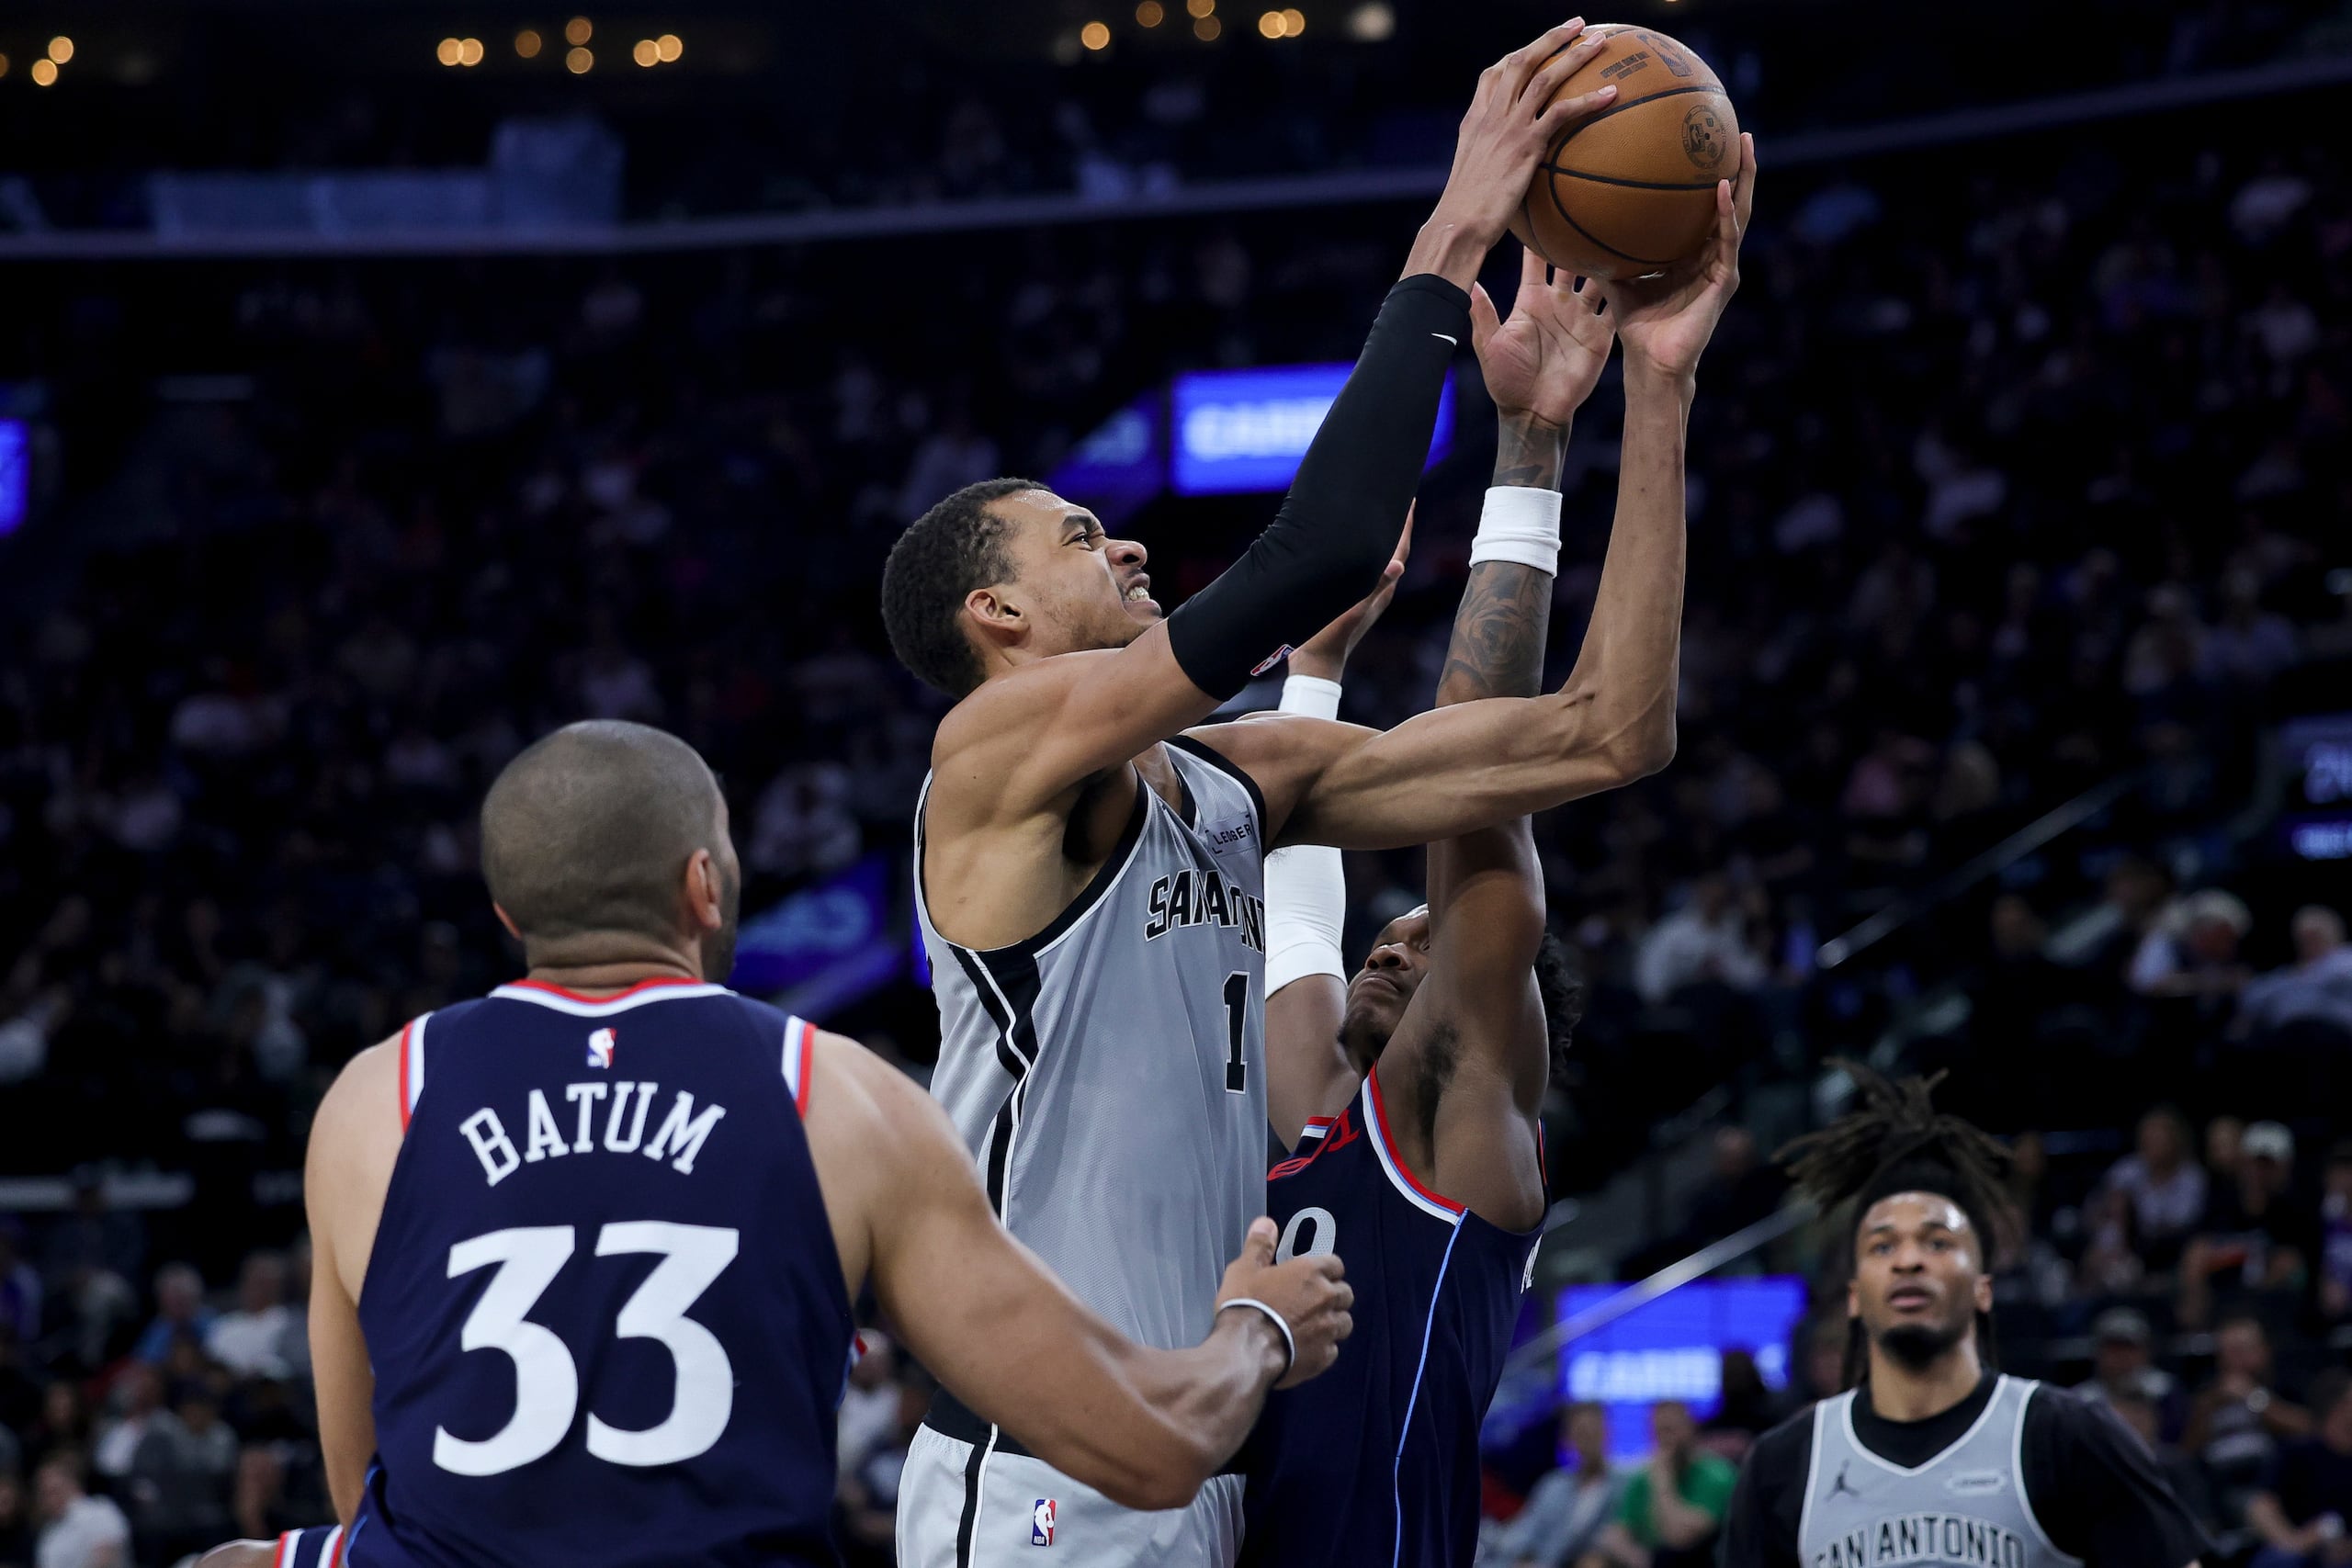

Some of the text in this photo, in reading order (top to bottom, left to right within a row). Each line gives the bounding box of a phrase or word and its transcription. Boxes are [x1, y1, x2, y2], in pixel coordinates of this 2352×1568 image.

[1223, 970, 1250, 1095] 1
[459, 1081, 727, 1187] BATUM
[433, 1220, 741, 1477] 33
[1876, 1512, 2025, 1568] ANTONIO
